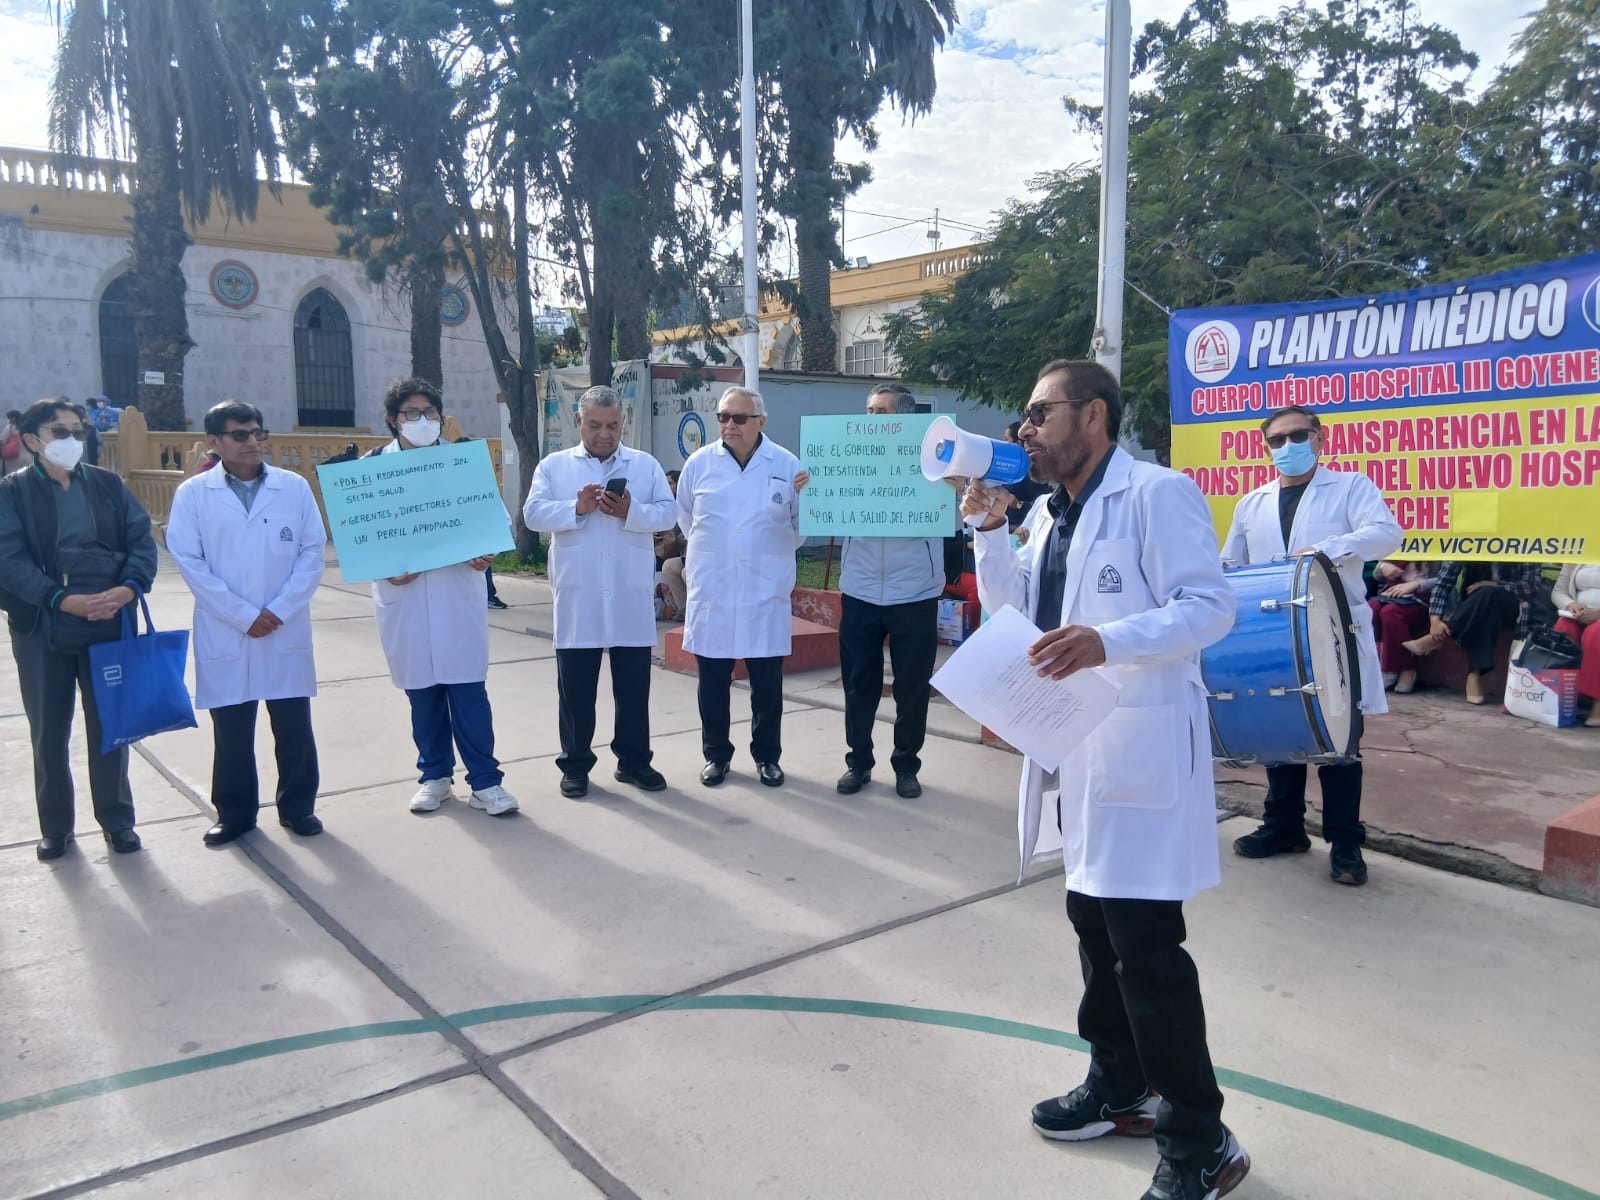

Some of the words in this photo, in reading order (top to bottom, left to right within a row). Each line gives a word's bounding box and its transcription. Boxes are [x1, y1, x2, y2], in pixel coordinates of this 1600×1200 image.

[1248, 299, 1406, 369] PLANTÓN
[1410, 278, 1568, 352] MÉDICO
[1191, 382, 1263, 416] CUERPO
[1265, 373, 1345, 409] MÉDICO
[1349, 362, 1460, 402] HOSPITAL
[1463, 359, 1491, 392] III
[1496, 348, 1600, 392] GOYENE
[846, 421, 902, 435] EXIGIMOS
[1220, 428, 1264, 462] POR
[1528, 407, 1567, 446] EN
[806, 443, 824, 458] QUE
[830, 443, 841, 457] EL
[844, 442, 886, 457] GOBIERNO
[808, 465, 820, 477] NO
[823, 465, 877, 477] DESATIENDA
[890, 464, 901, 476] LA
[1366, 457, 1412, 491] DEL
[1418, 452, 1513, 490] NUEVO
[807, 487, 819, 497] DE
[825, 487, 834, 497] LA
[870, 486, 917, 498] AREQUIPA
[398, 499, 452, 516] DIRECTORES
[841, 510, 856, 525] LA
[860, 510, 888, 524] SALUD
[889, 511, 904, 525] DEL
[354, 534, 369, 545] UN
[376, 527, 407, 541] PERFIL
[1439, 536, 1585, 556] VICTORIAS!!!
